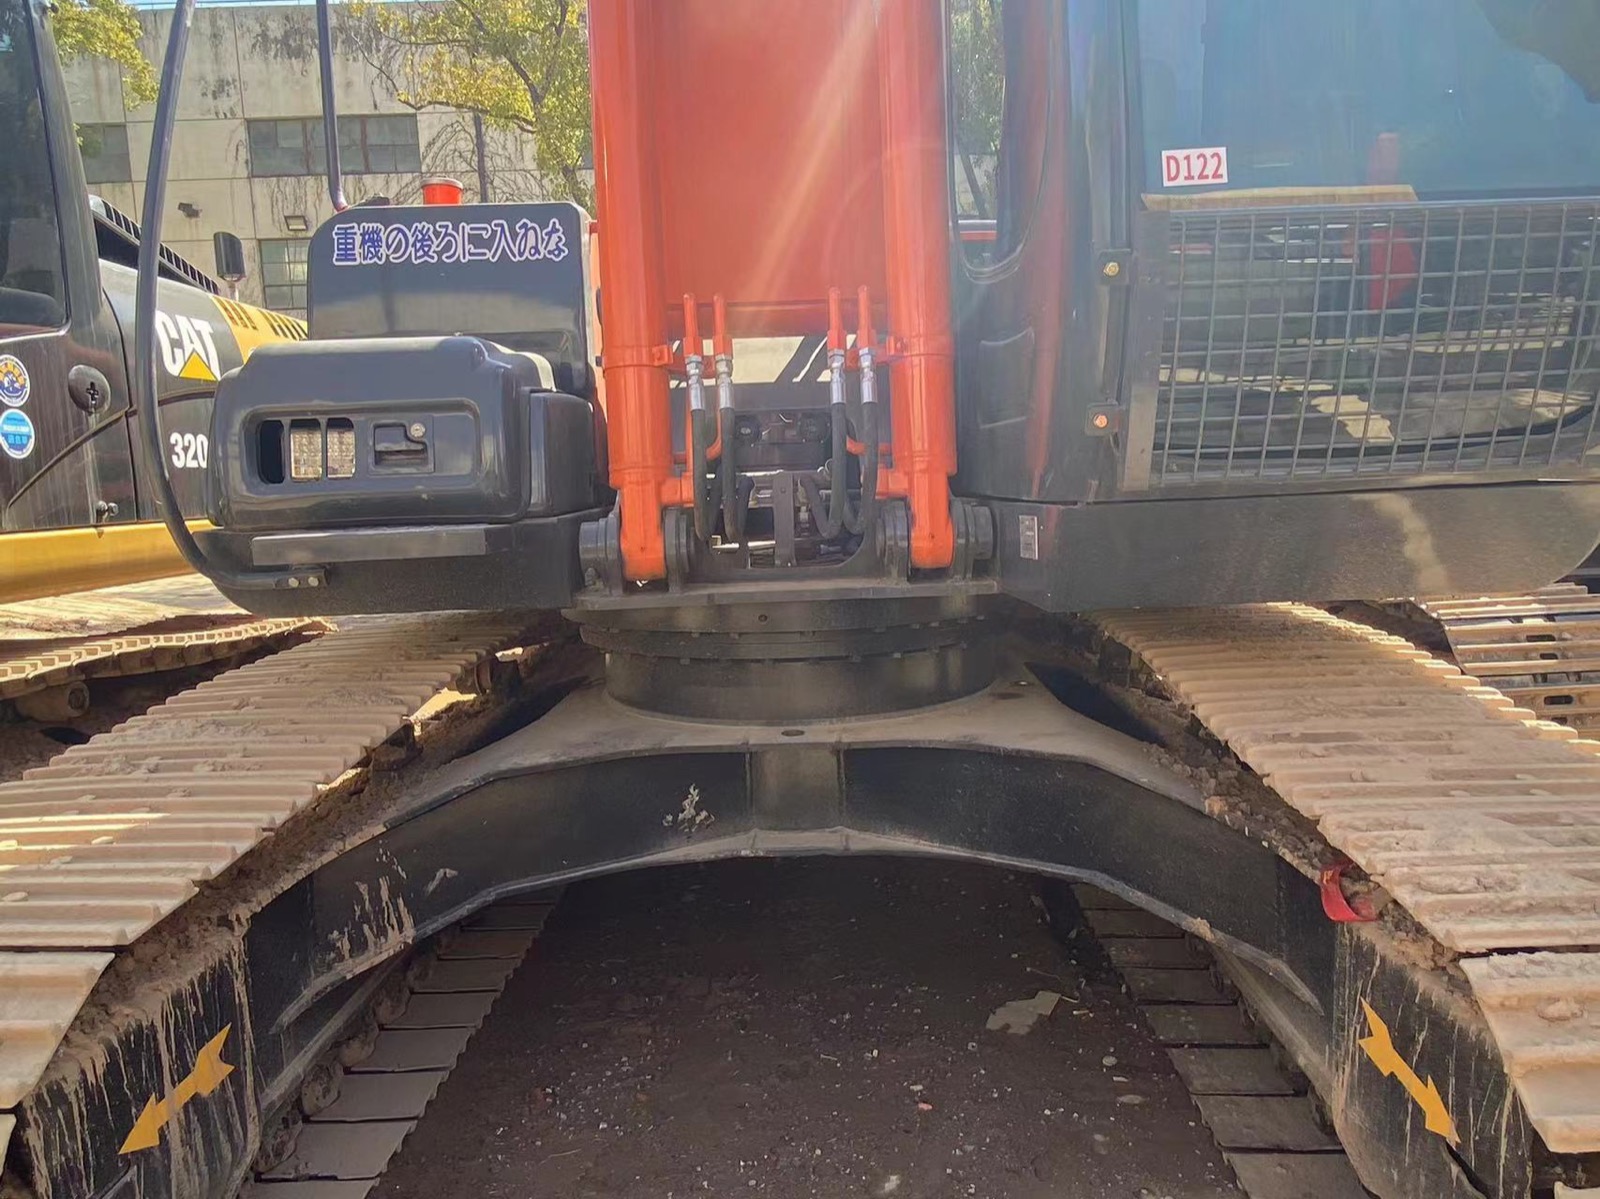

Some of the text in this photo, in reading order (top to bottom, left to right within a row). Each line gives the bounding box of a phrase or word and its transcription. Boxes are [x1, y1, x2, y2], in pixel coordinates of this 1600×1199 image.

[1166, 152, 1223, 182] D122
[155, 309, 222, 382] CAT
[169, 432, 209, 469] 320
